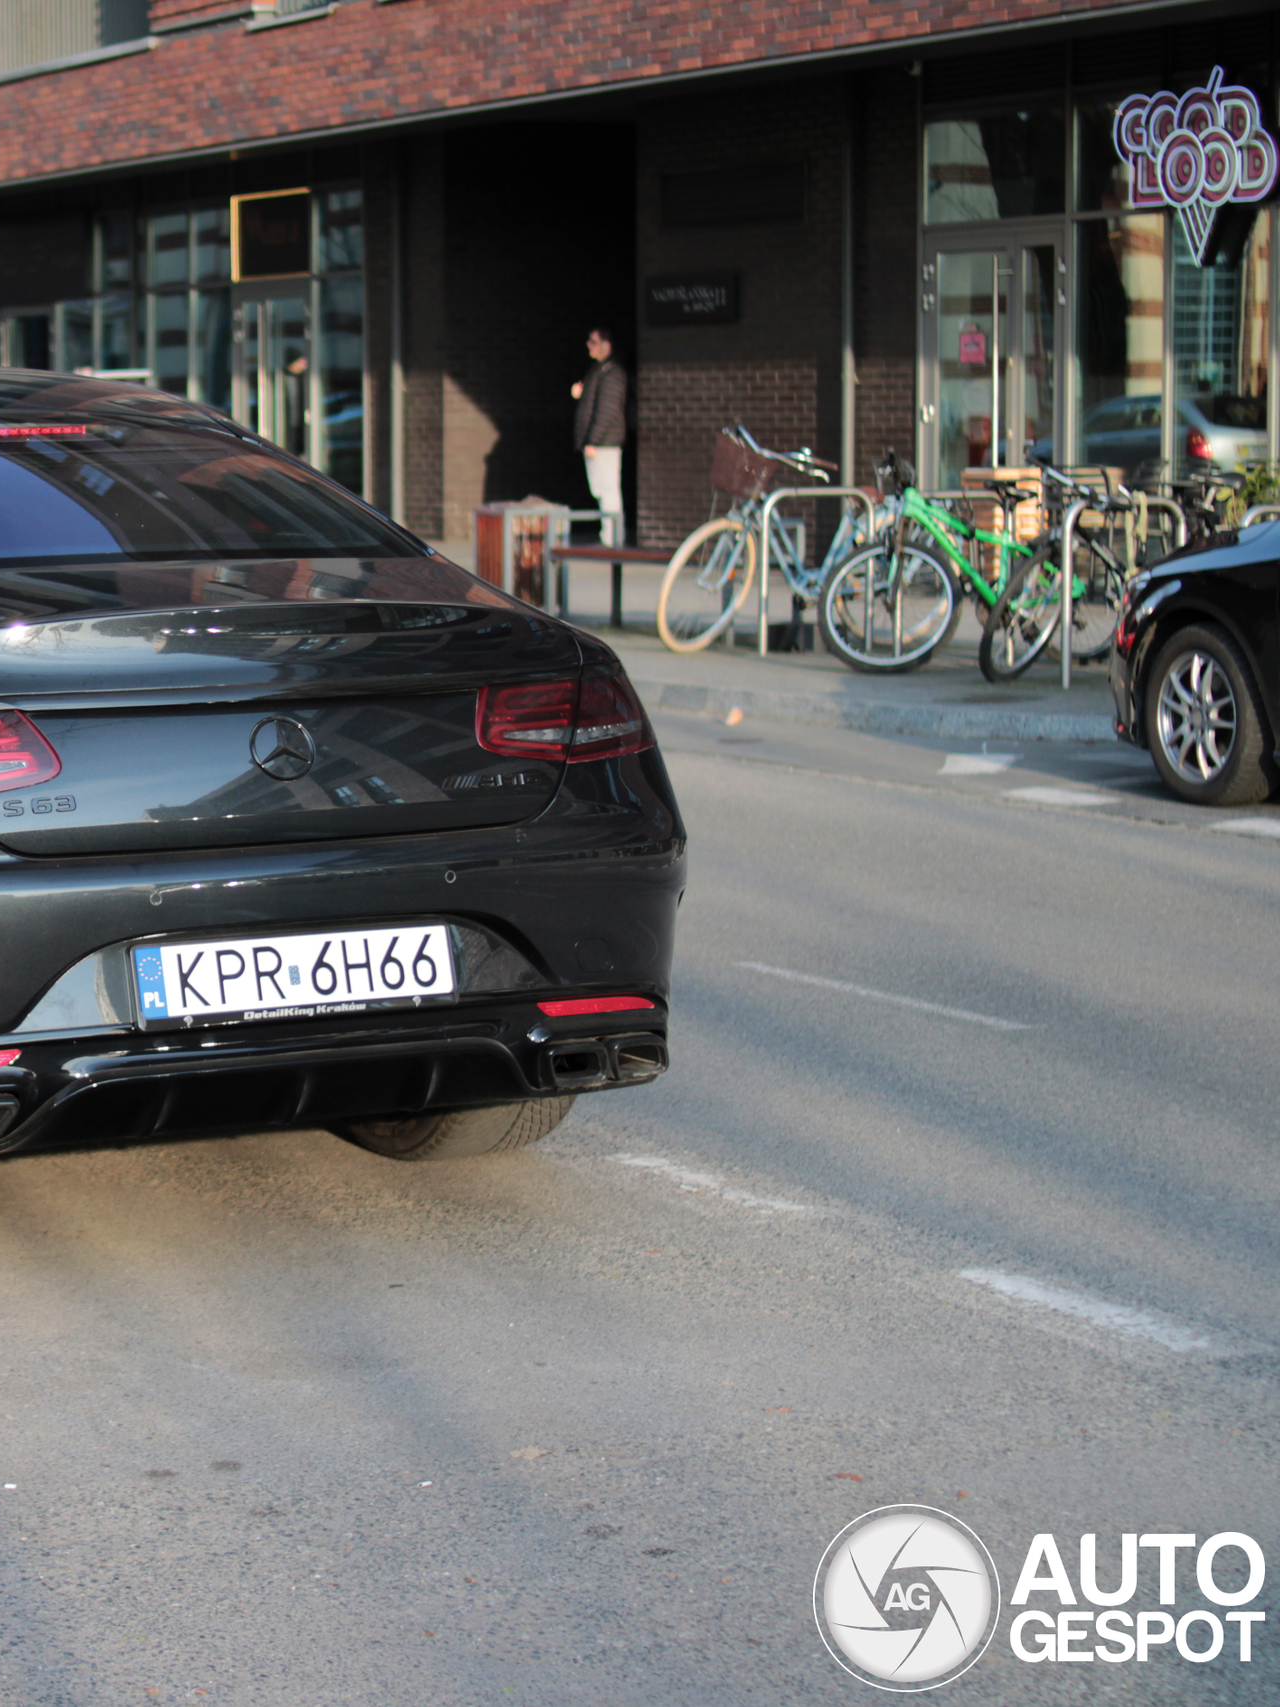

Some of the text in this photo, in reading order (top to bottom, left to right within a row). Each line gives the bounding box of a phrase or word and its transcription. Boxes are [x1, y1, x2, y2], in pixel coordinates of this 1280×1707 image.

[1113, 84, 1261, 162] GOOD
[1129, 127, 1277, 208] LOOD
[3, 794, 77, 817] S 63
[176, 933, 437, 1009] KPR 6H66
[143, 991, 166, 1009] PL
[243, 1001, 367, 1021] DetailKing Kraków
